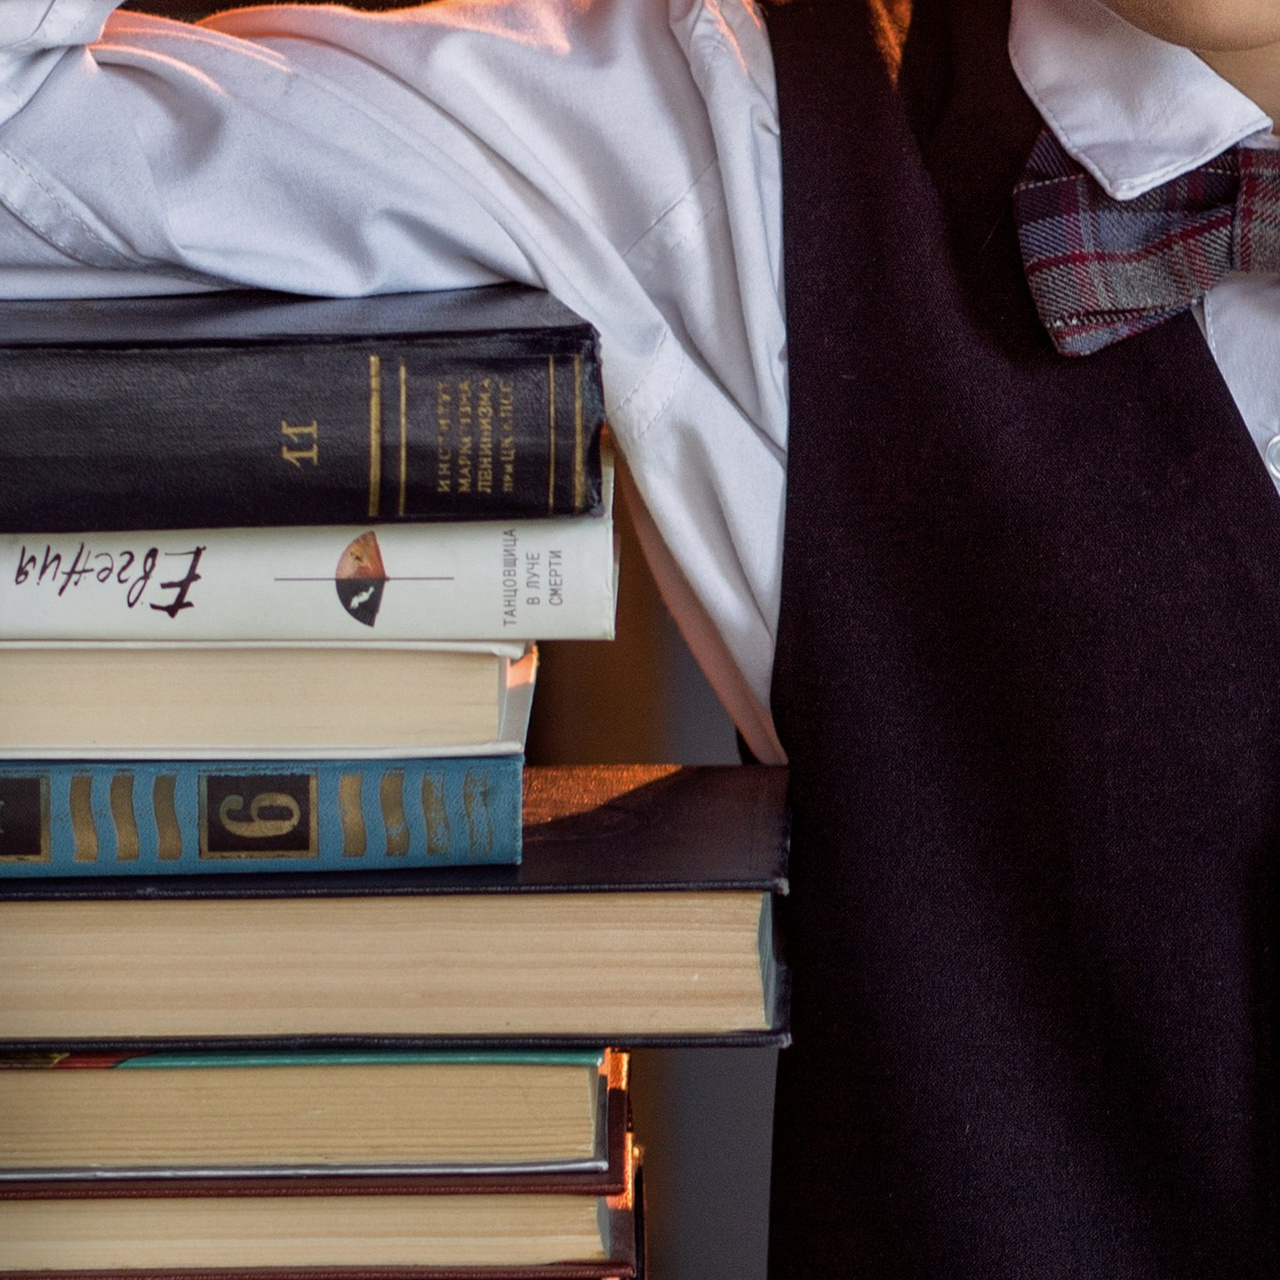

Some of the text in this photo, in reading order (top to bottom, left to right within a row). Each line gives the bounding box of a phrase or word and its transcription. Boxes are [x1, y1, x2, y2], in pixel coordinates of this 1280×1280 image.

[281, 419, 318, 468] 11
[14, 541, 207, 619] Евгения
[503, 528, 519, 628] ТАНЦОВЩИЦА
[526, 552, 541, 606] В ЛУЧЕ
[548, 549, 564, 607] СМЕРТИ
